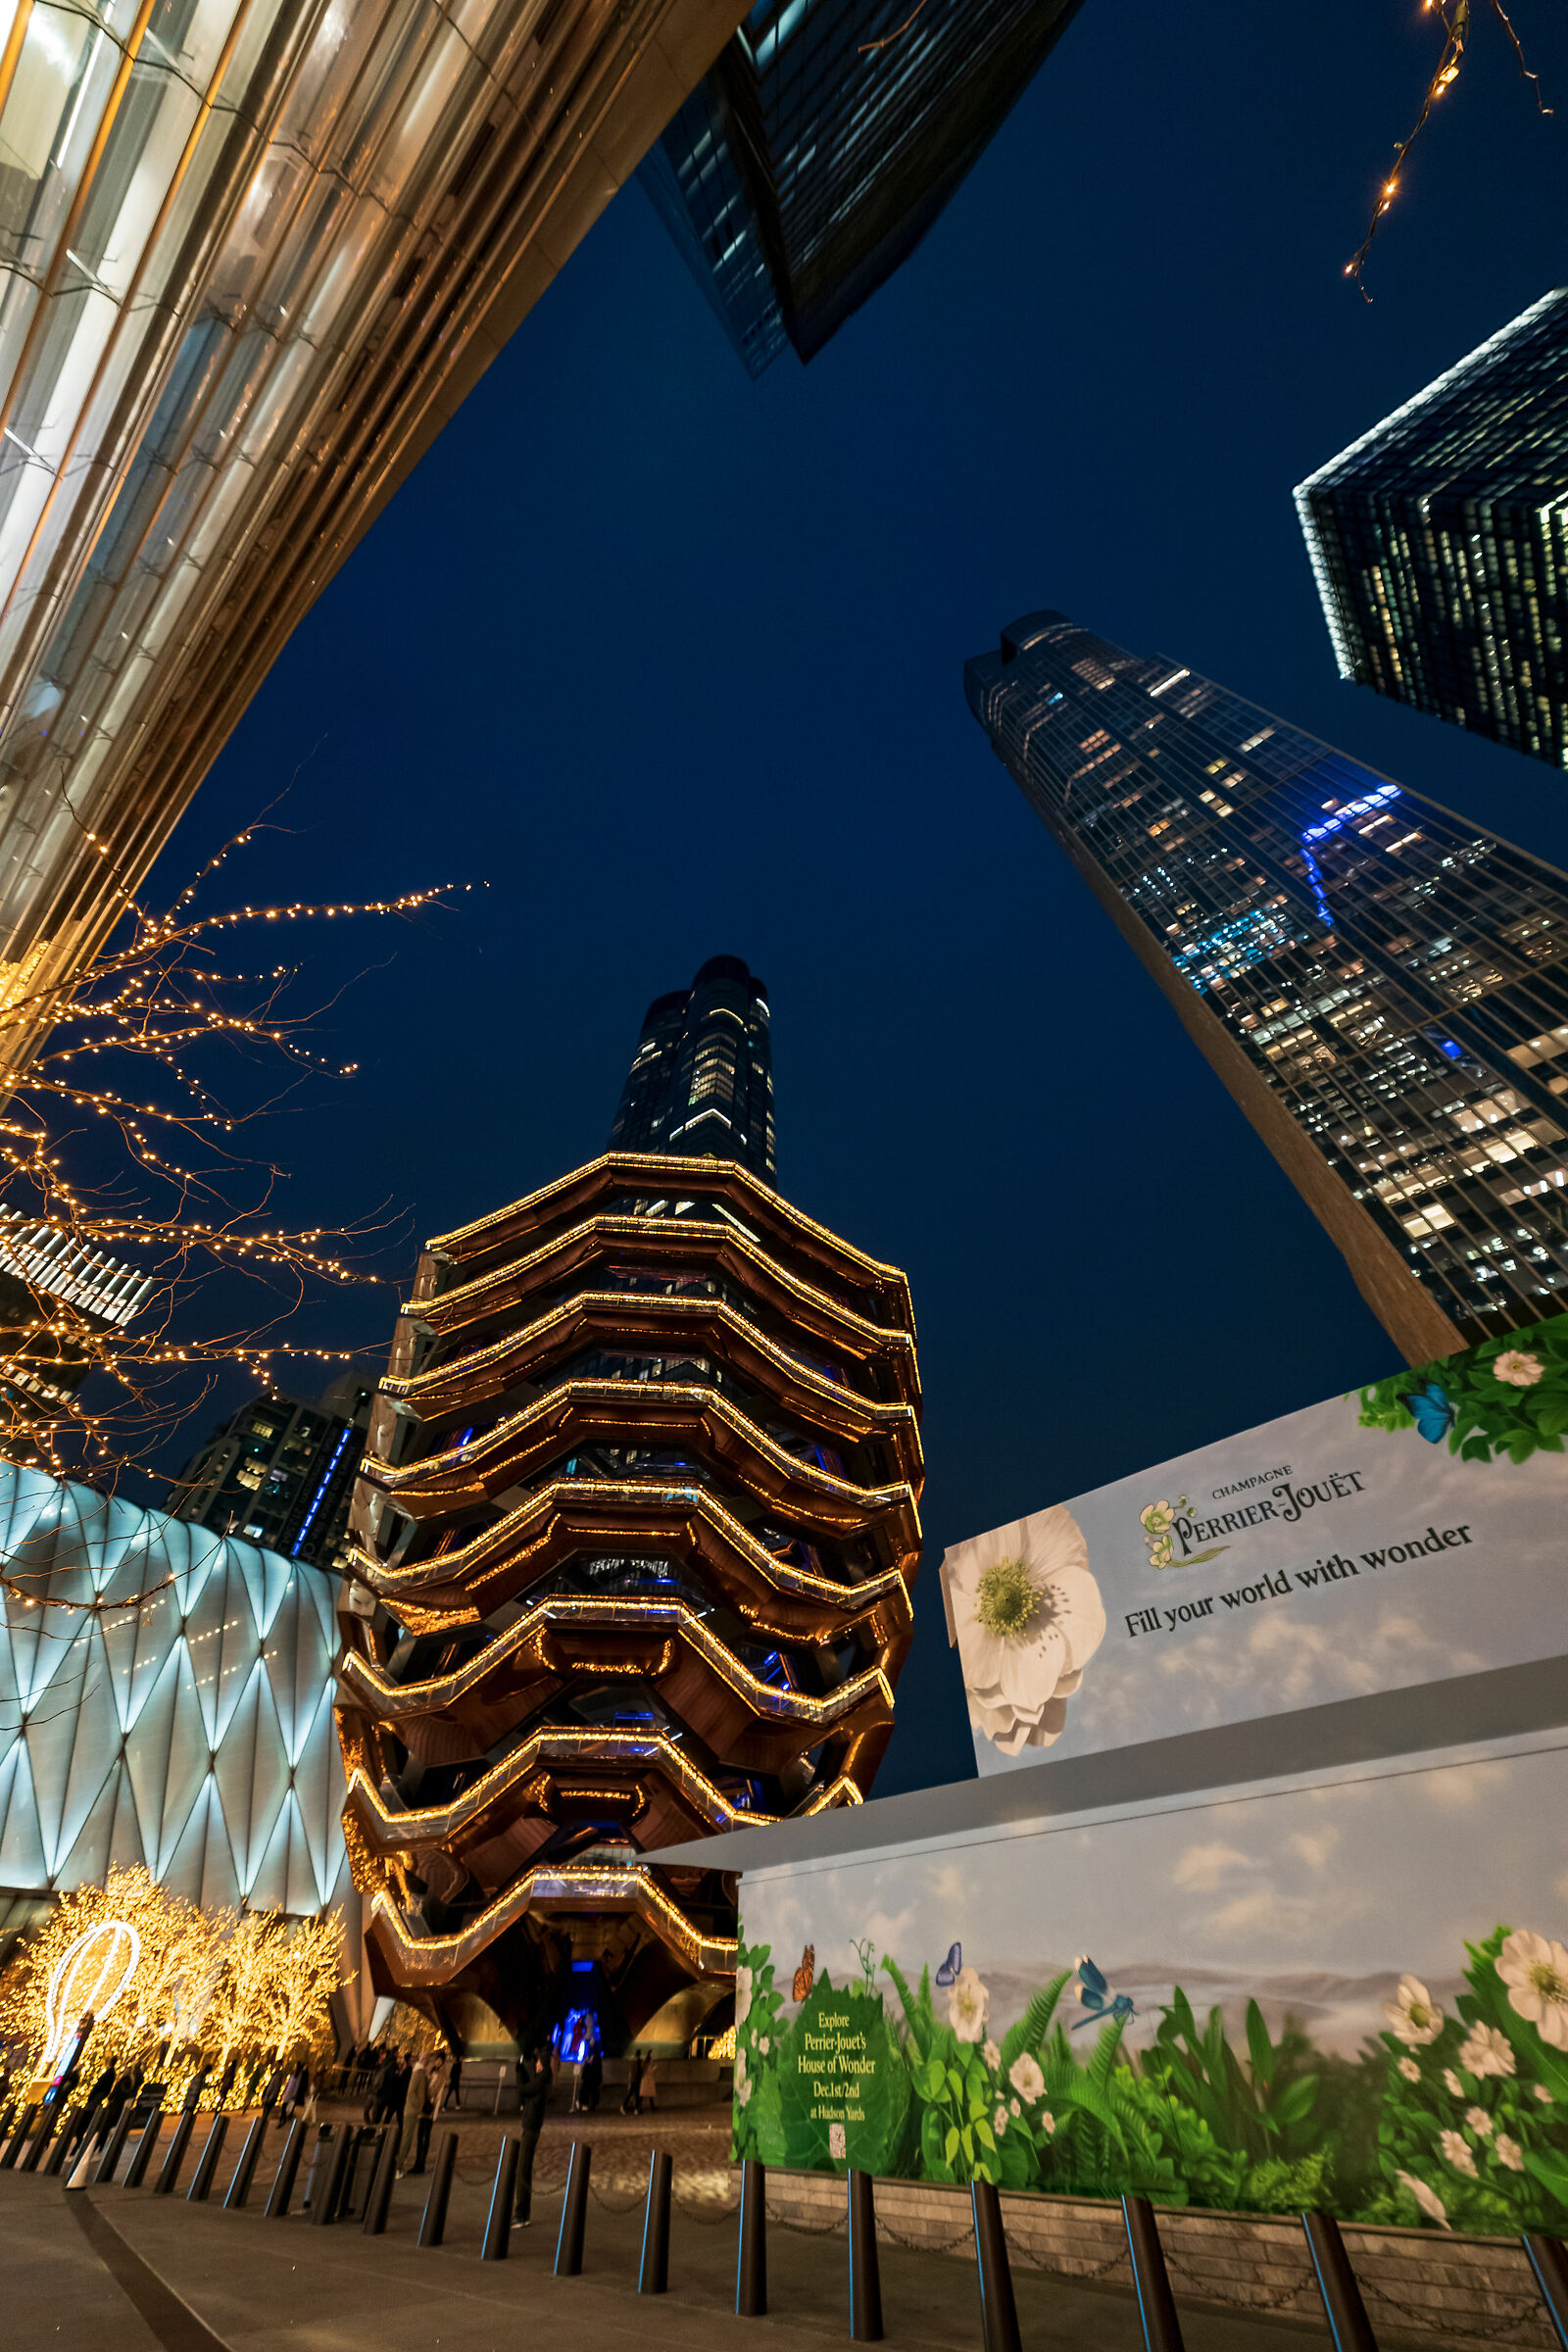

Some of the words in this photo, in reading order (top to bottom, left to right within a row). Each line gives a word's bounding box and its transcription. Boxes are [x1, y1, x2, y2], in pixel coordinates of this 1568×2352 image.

[1212, 1465, 1294, 1499] CHAMPAGNE
[1173, 1470, 1366, 1556] PERRIER-JOUËT
[1125, 1607, 1162, 1638] Fill
[1164, 1597, 1214, 1632] your
[1219, 1570, 1294, 1609] world
[1295, 1554, 1360, 1589] with
[1359, 1525, 1474, 1569] wonder
[818, 2012, 850, 2032] Explore
[798, 2055, 825, 2074] House
[827, 2055, 838, 2074] of
[838, 2055, 876, 2075] Wonder
[810, 2107, 817, 2119] at
[818, 2104, 845, 2120] Hudson
[845, 2104, 865, 2122] Yards
